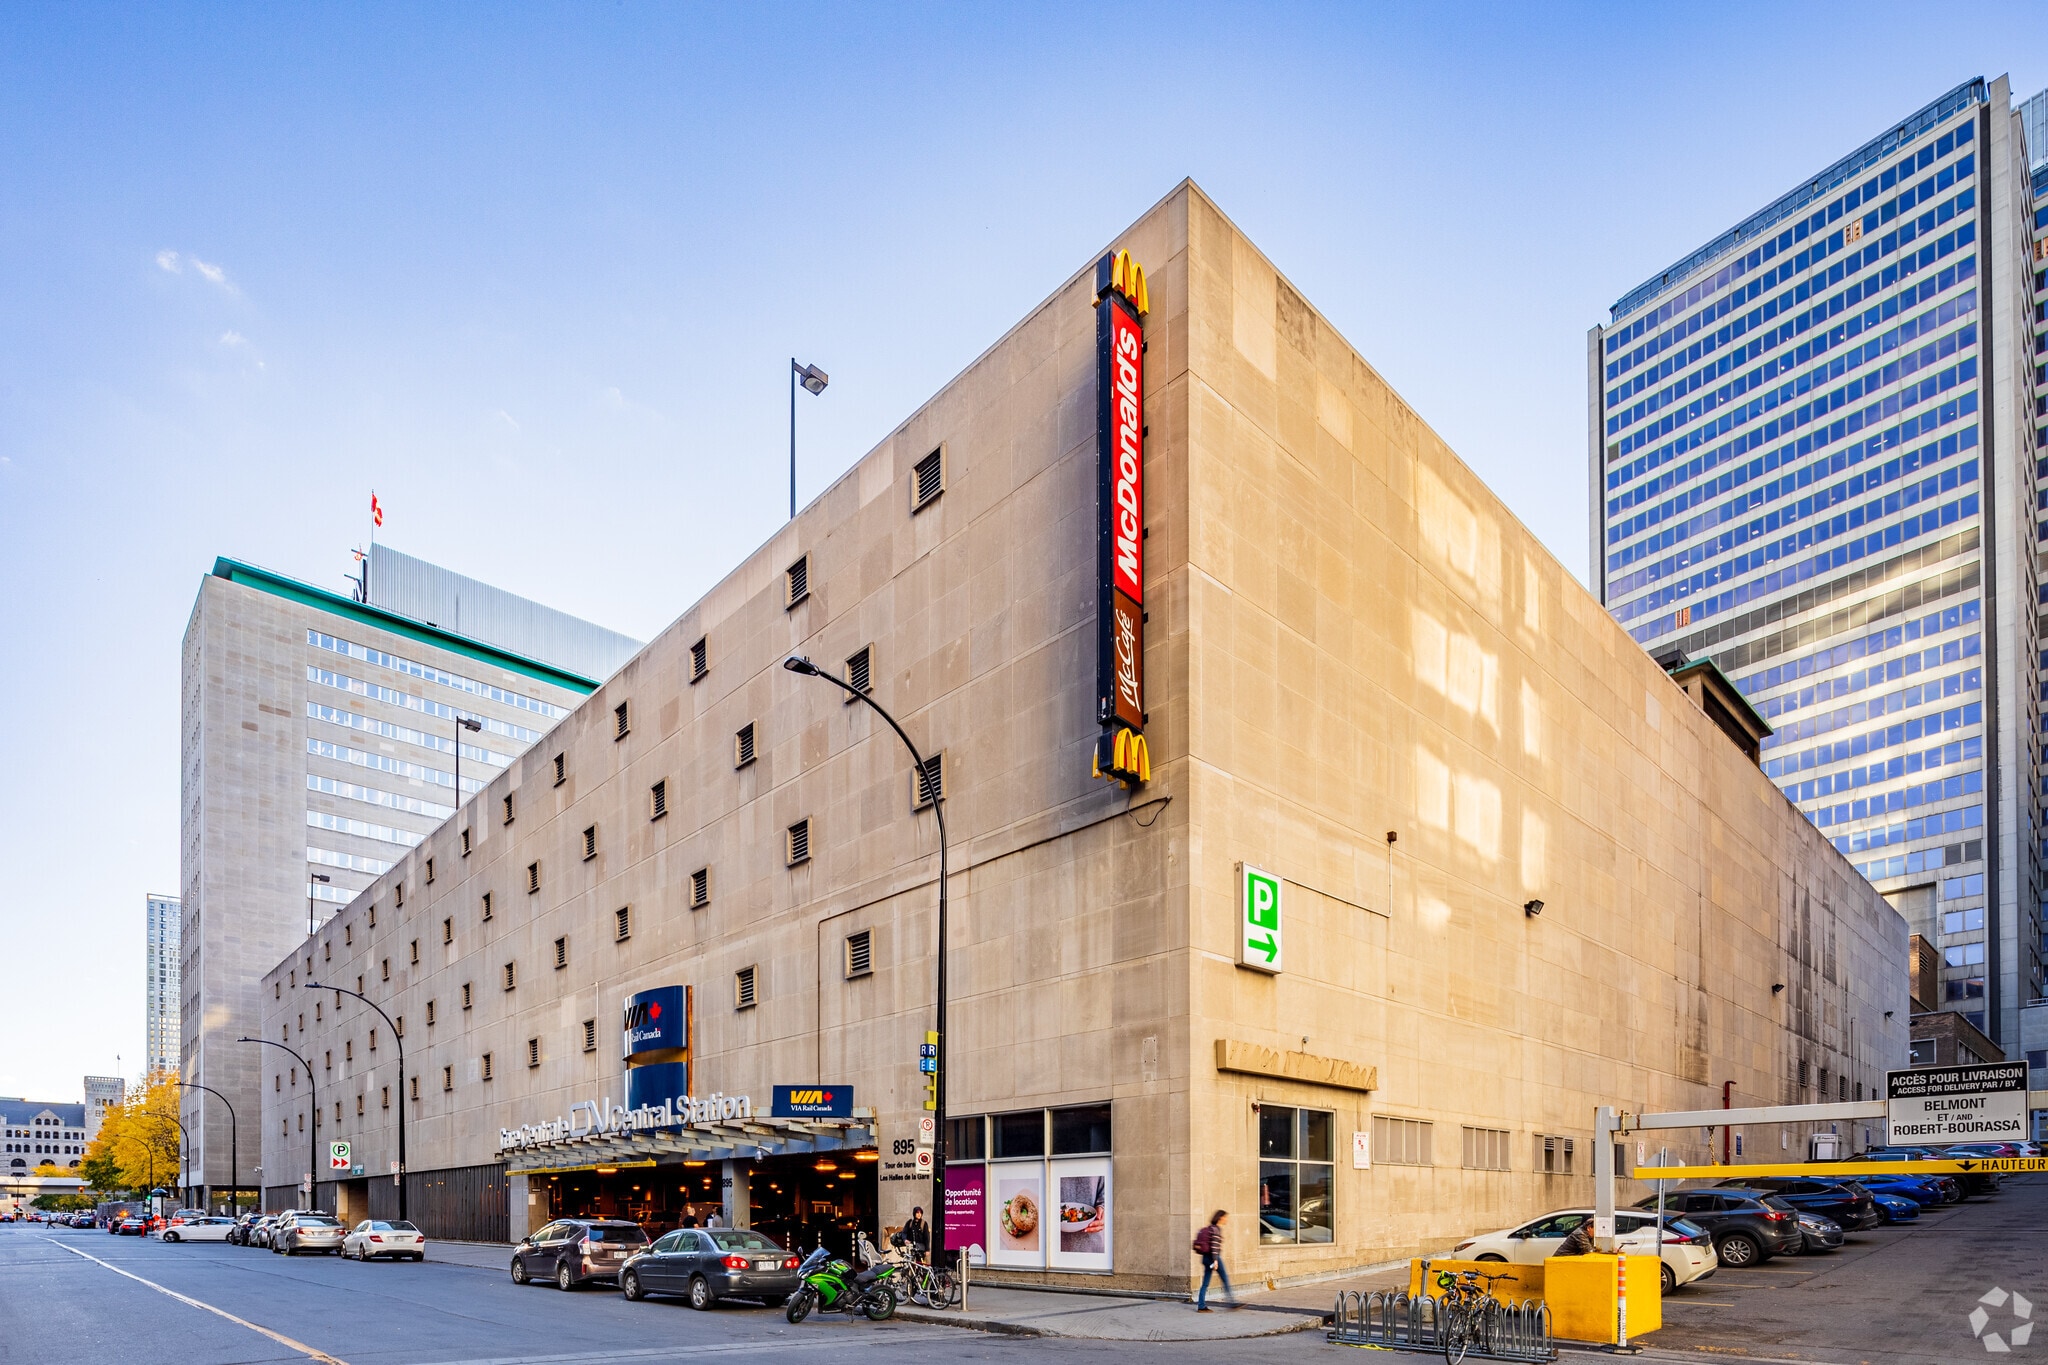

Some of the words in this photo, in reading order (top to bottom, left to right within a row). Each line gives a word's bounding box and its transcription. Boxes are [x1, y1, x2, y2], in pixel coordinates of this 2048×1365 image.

[1117, 327, 1138, 585] McDonald's
[1115, 608, 1141, 712] McCafé
[1254, 879, 1273, 922] P
[624, 1002, 648, 1031] VIA
[640, 1028, 661, 1041] Canada
[1892, 1074, 1926, 1086] ACCÈS
[1930, 1072, 1959, 1084] POUR
[1962, 1068, 2023, 1081] LIVRAISON
[1897, 1085, 1926, 1095] ACCESS
[1928, 1085, 1943, 1093] FOR
[1944, 1082, 1980, 1091] DELIVERY
[1982, 1081, 1998, 1089] PAR
[791, 1091, 822, 1104] VIA
[1924, 1098, 1987, 1111] BELMONT
[610, 1098, 671, 1131] Central
[676, 1092, 750, 1124] Station
[1937, 1113, 1949, 1122] ET
[1893, 1120, 2021, 1136] ROBERT-BOURASSA
[338, 1146, 346, 1154] P
[893, 1139, 915, 1155] 895
[1981, 1159, 2046, 1171] HAUTEUR
[945, 1188, 981, 1198] Opportunité
[945, 1198, 953, 1206] de
